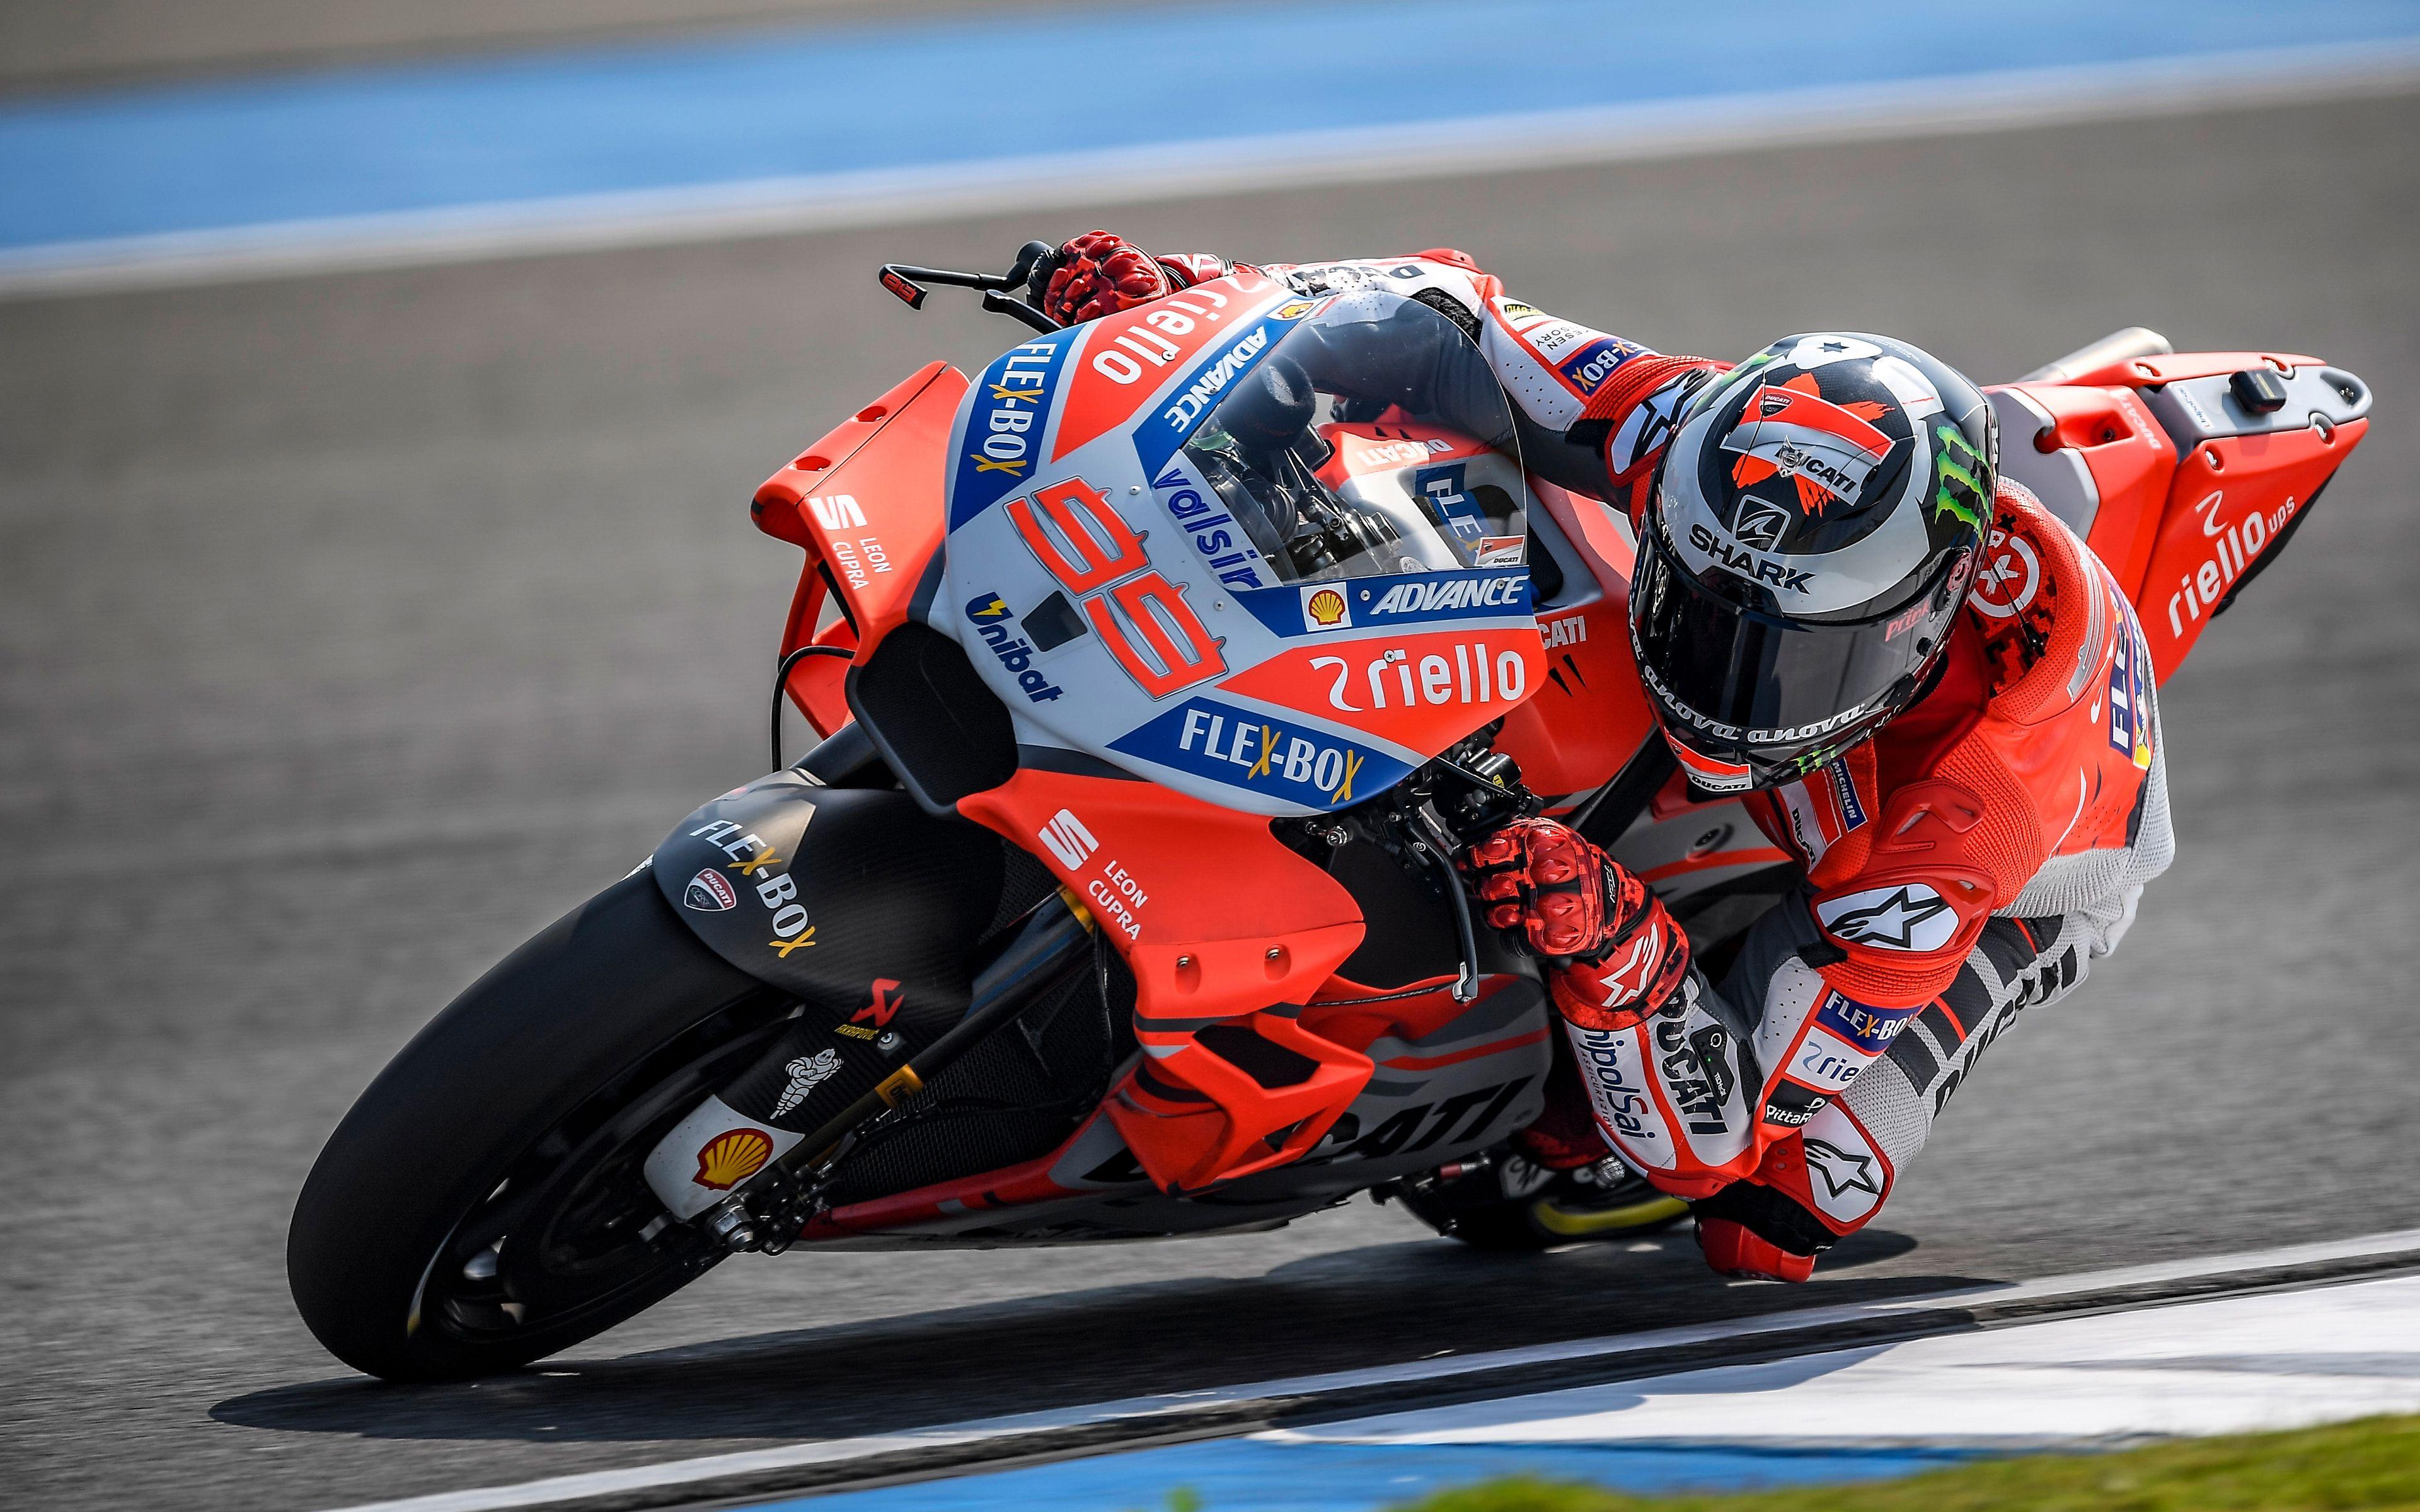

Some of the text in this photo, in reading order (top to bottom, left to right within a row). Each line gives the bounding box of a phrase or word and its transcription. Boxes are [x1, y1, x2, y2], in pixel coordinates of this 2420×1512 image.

[883, 273, 916, 302] 99
[1093, 289, 1228, 384] riello
[970, 343, 1057, 476] FLEX-BOX
[1164, 326, 1267, 433] ADVANCE
[860, 537, 892, 574] LEON
[1152, 469, 1263, 590] valsir
[1688, 524, 1816, 594] SHARK
[833, 541, 869, 591] CUPRA
[1003, 475, 1230, 702] 99
[1371, 575, 1528, 615] ADVANCE
[2168, 496, 2296, 639] riello ups
[964, 592, 1063, 704] Unibat
[1541, 616, 1587, 650] CATI
[1368, 644, 1526, 710] riello
[1644, 665, 1739, 740] anova
[1747, 705, 1864, 742] anova
[1179, 709, 1364, 805] FLEX-BOX
[1691, 776, 1747, 790] DUCATI
[1833, 762, 1857, 819] MICHELIN
[689, 820, 816, 958] FLEX-BOX
[704, 873, 732, 906] DUCATI
[1088, 880, 1143, 941] CUPRA
[1103, 860, 1148, 908] LEON
[1825, 990, 1915, 1040] FLEX-BO
[1578, 1031, 1656, 1138] nipolSai
[1581, 1051, 1613, 1130] ASSICURAZION
[1766, 1104, 1816, 1125] PittaR
